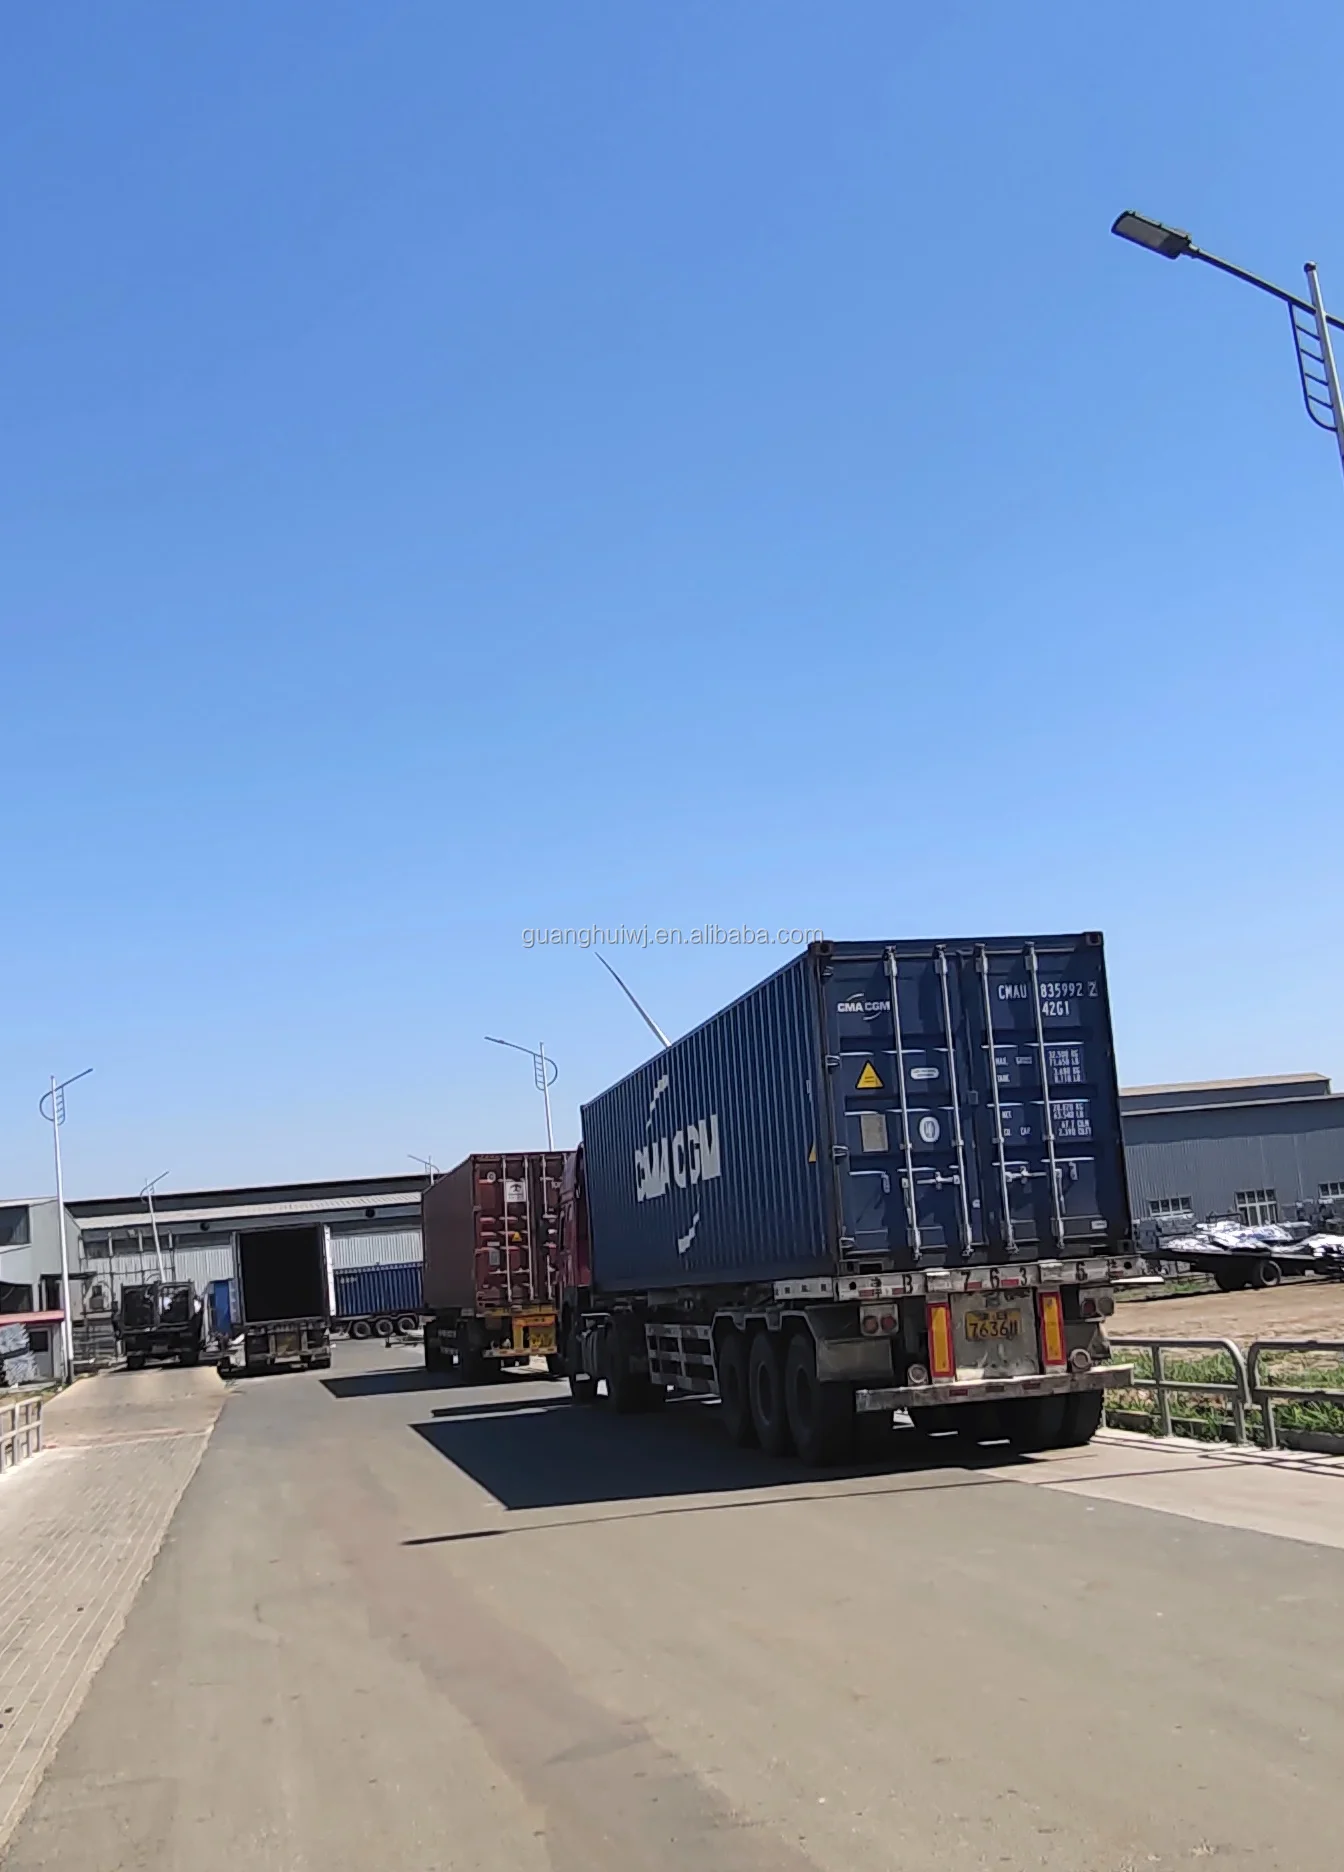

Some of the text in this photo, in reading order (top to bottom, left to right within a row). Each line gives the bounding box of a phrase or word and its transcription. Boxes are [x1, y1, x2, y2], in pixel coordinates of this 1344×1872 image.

[998, 982, 1098, 1000] CMAU 835992 2
[837, 1001, 891, 1012] CMA CGM
[1042, 1001, 1070, 1016] 42G1
